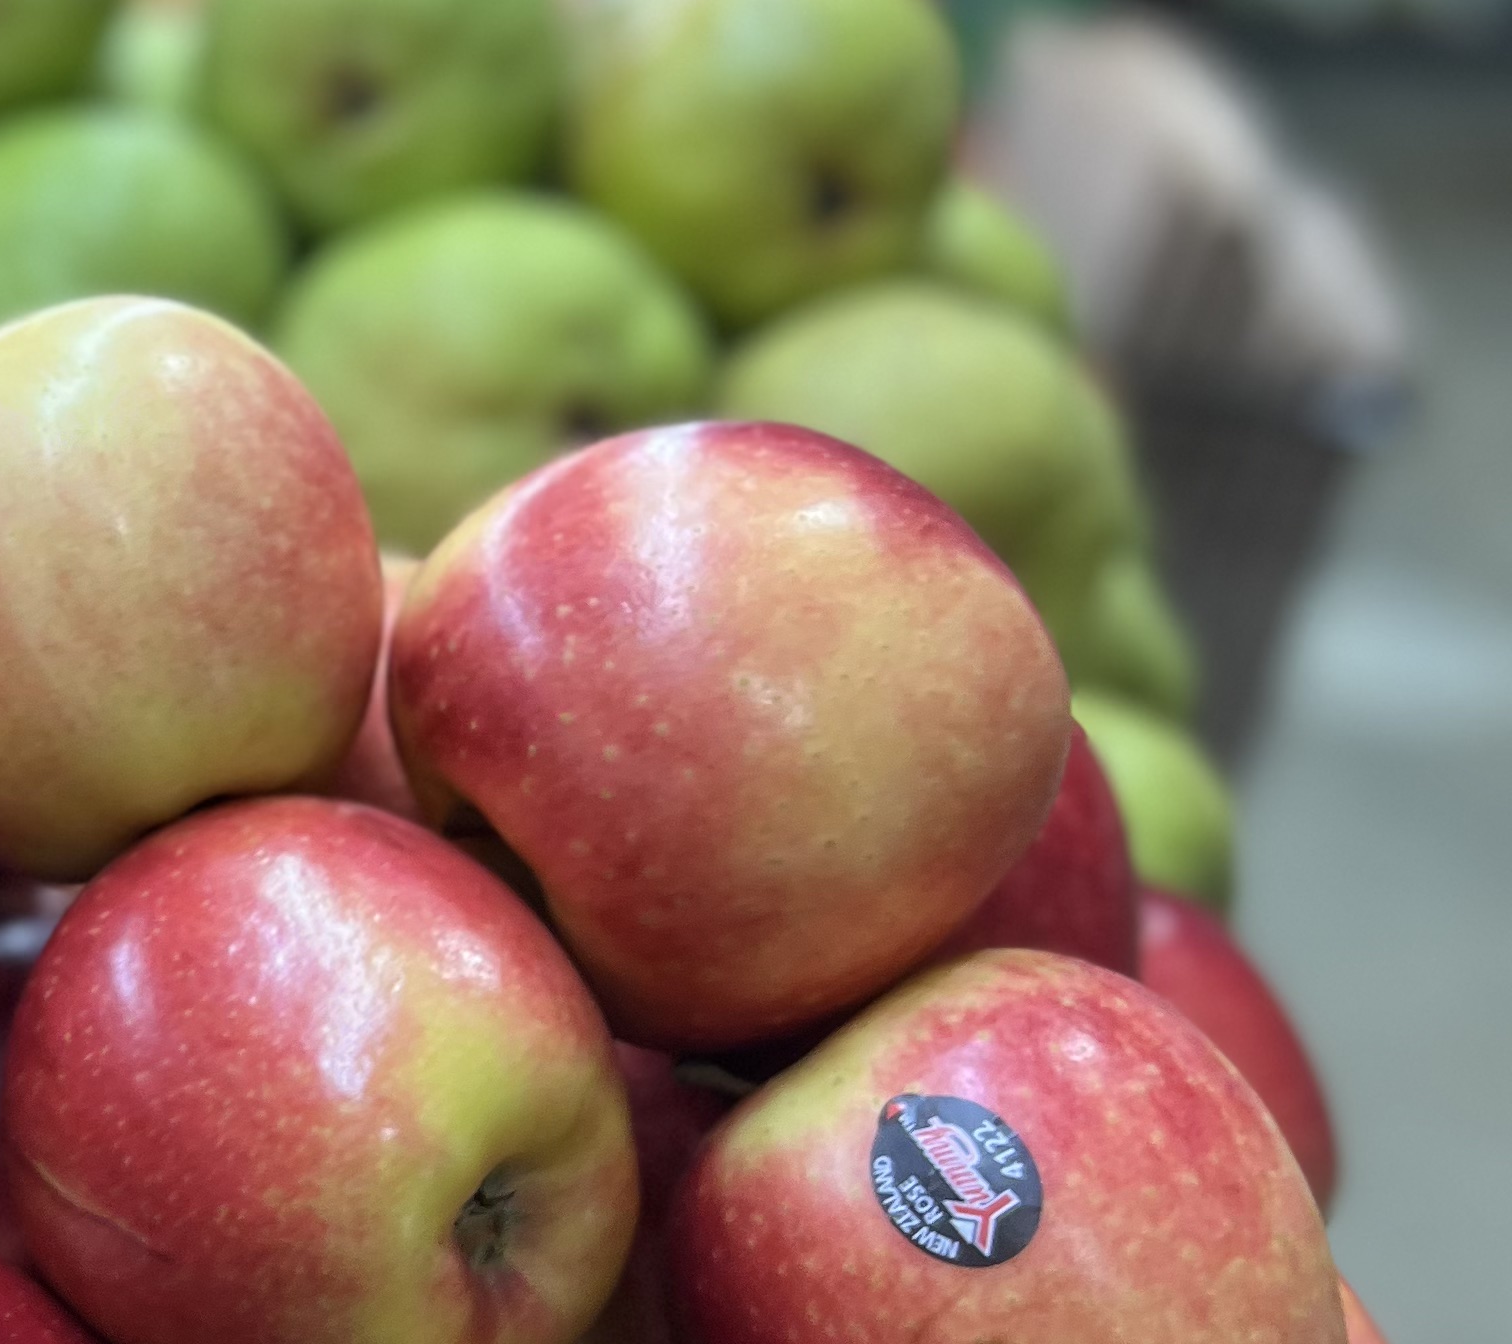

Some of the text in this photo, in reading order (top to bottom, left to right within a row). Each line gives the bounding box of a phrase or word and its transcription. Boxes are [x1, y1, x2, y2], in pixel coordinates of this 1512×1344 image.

[913, 1115, 1022, 1258] Yummy
[972, 1119, 1024, 1179] 4122
[873, 1155, 961, 1259] NEW ZEALAND
[898, 1174, 944, 1225] ROSE
